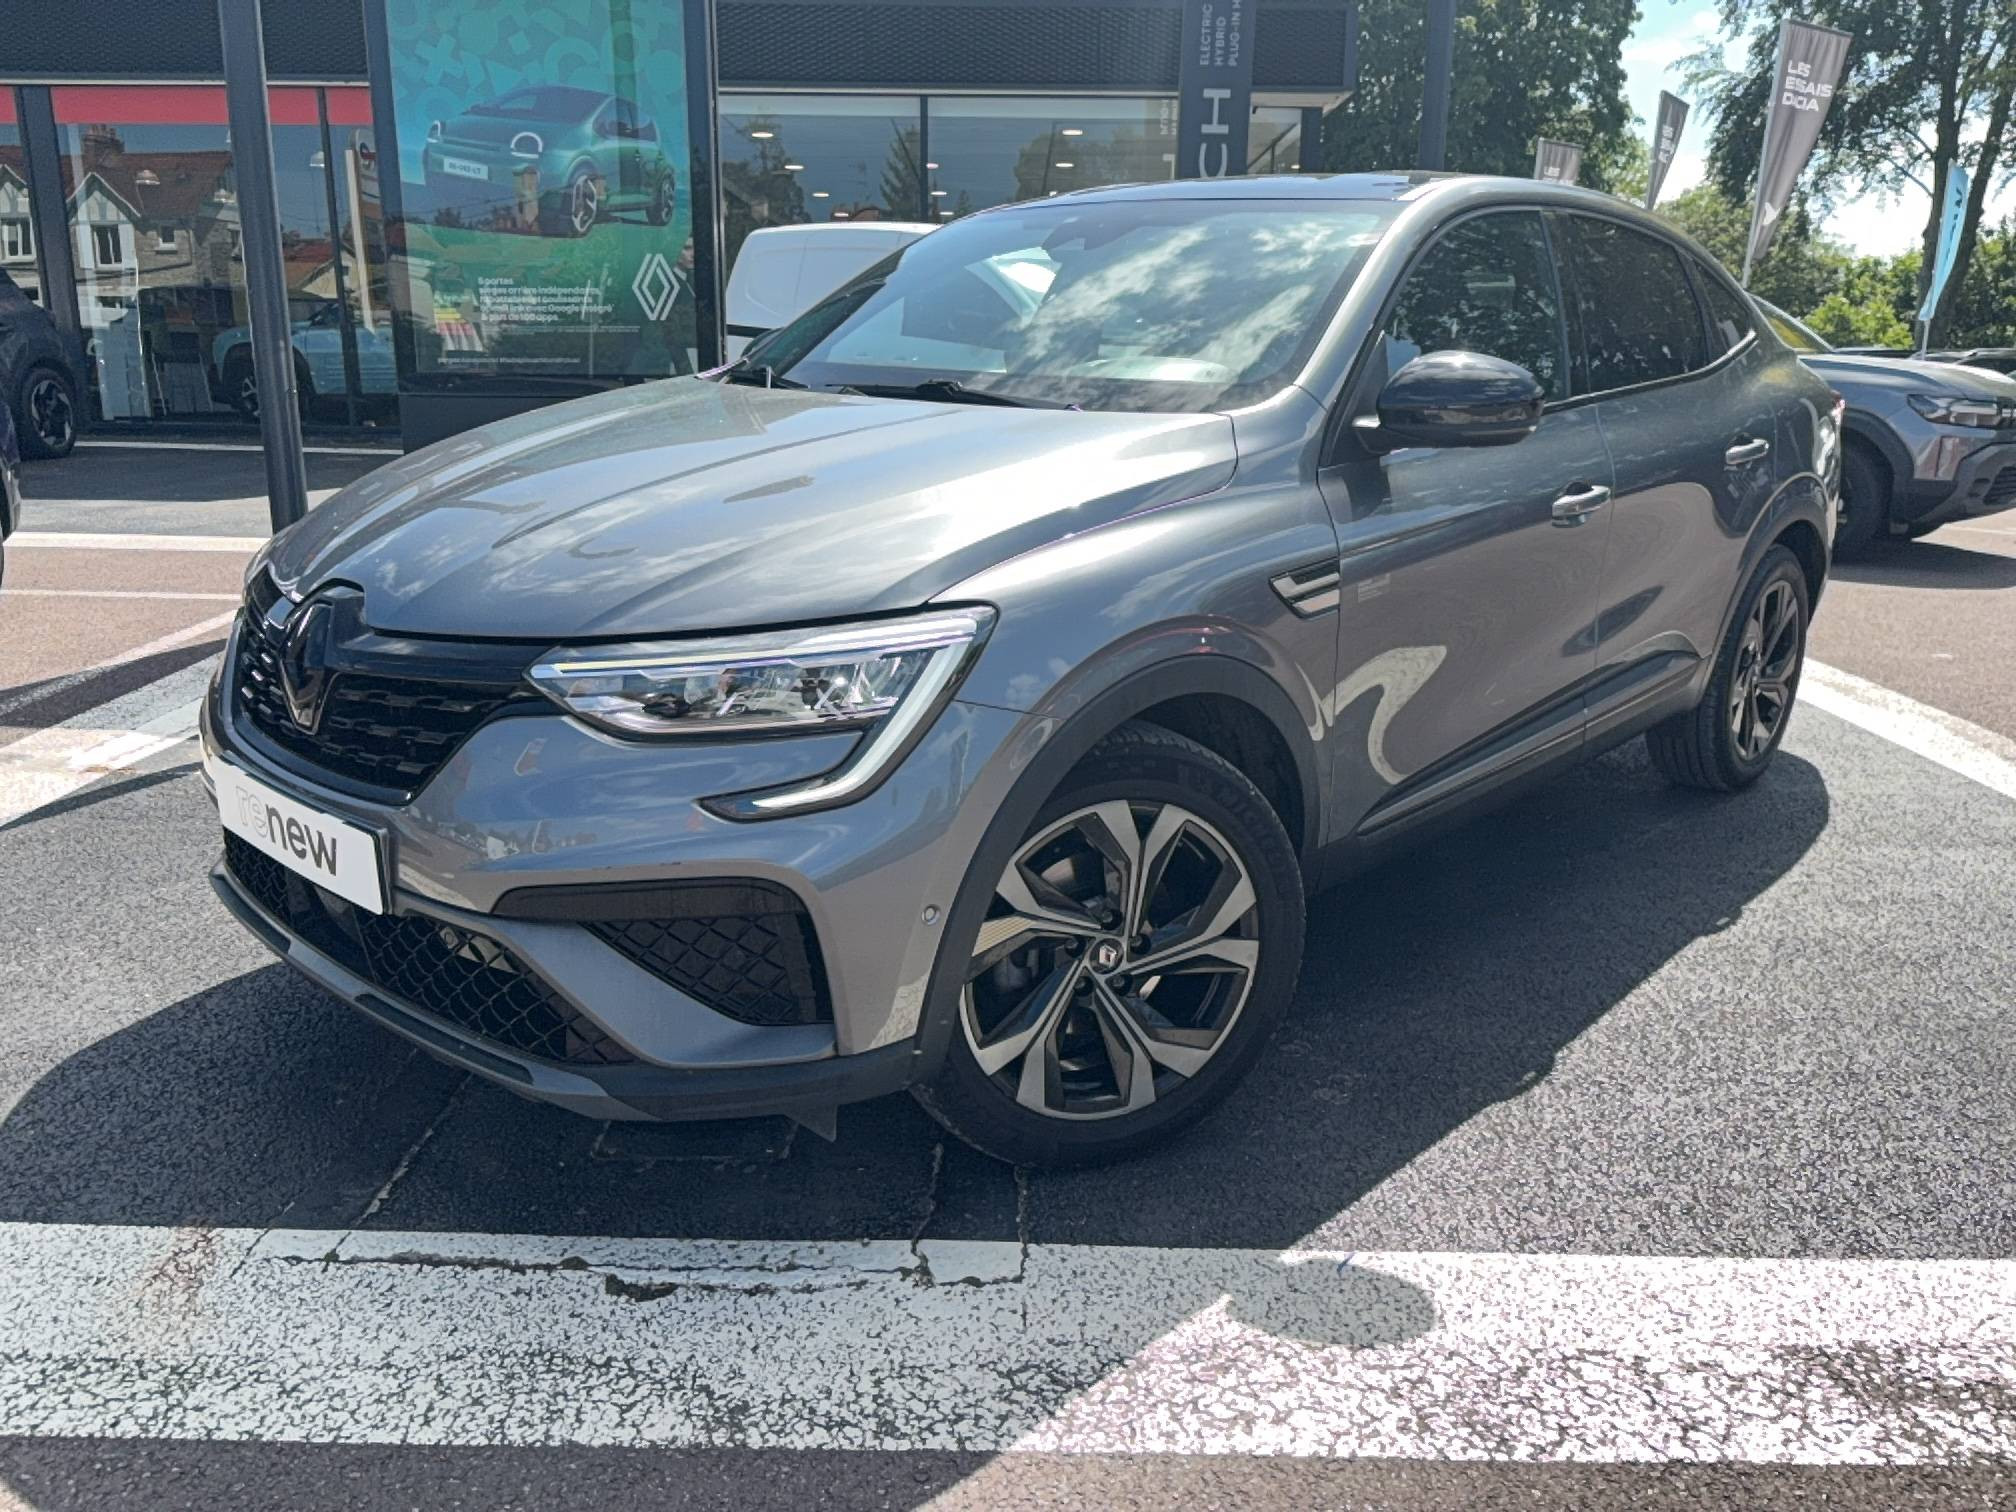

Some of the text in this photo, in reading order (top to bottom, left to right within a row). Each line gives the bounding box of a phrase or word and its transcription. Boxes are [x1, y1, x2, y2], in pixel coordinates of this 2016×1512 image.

[1200, 4, 1213, 65] ELECTRIC
[1214, 16, 1226, 66] HYBRID
[1228, 12, 1241, 66] PLUG-IN
[1788, 60, 1811, 77] LES
[485, 278, 513, 287] portes
[548, 304, 579, 314] Google
[235, 785, 337, 876] renew
